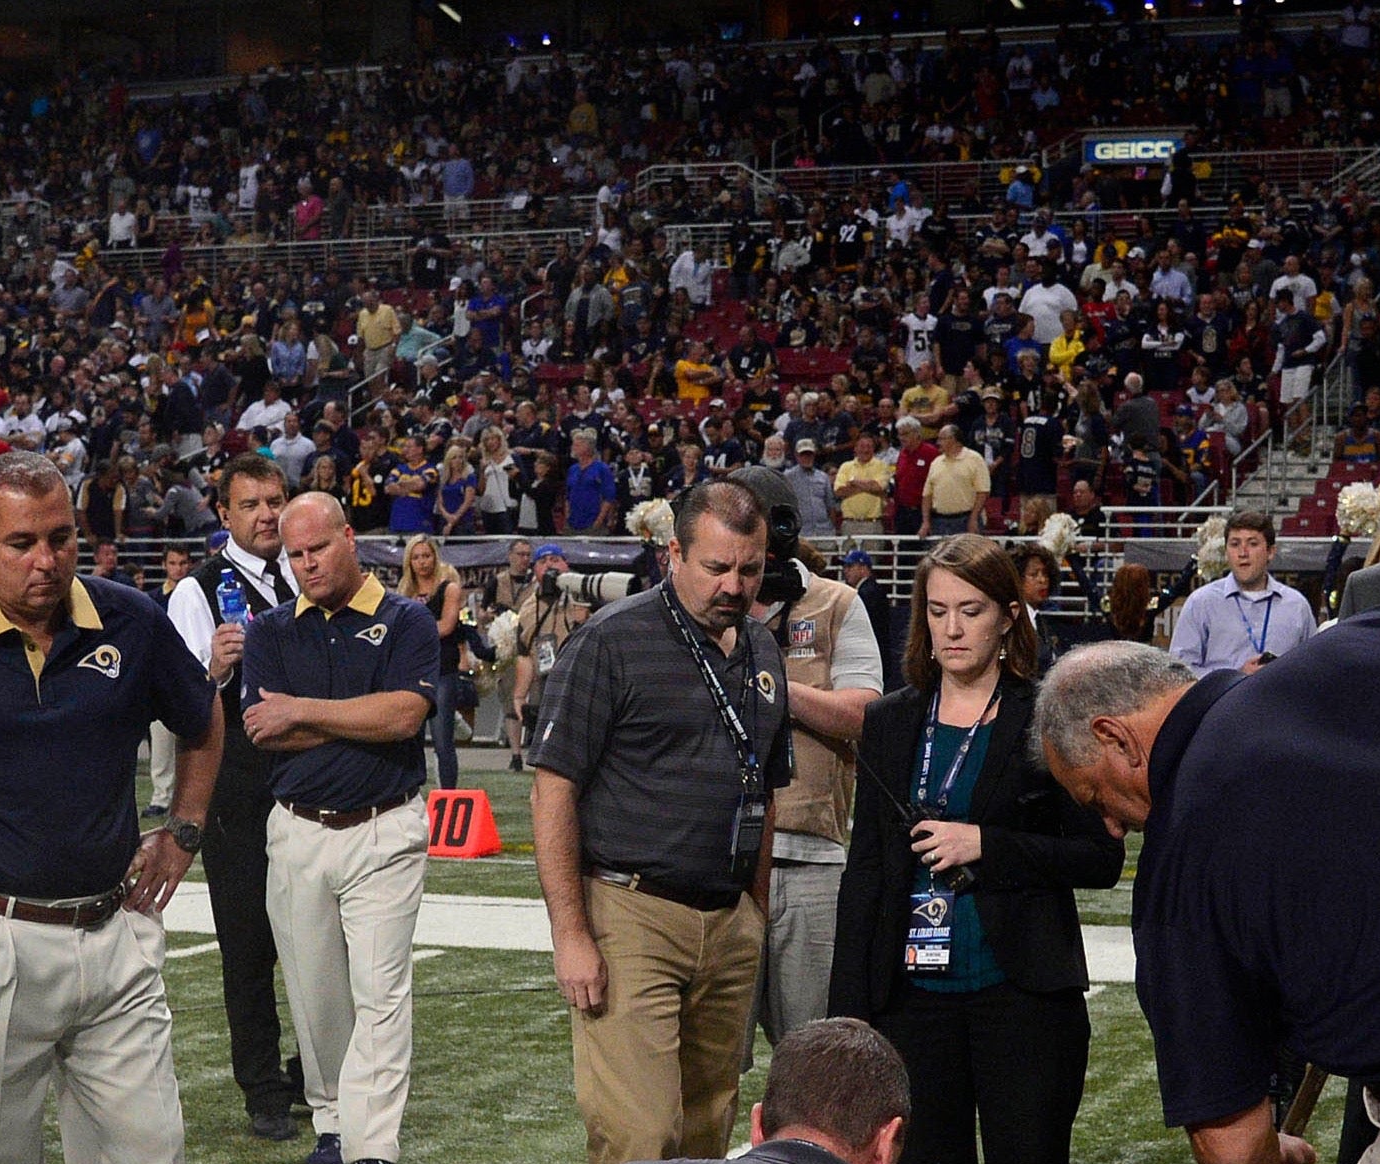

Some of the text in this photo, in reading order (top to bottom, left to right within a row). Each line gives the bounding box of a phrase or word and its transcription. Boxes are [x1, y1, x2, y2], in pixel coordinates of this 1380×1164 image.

[1094, 141, 1176, 160] GEICO
[839, 224, 858, 243] 92
[1021, 427, 1038, 459] 8
[351, 481, 374, 507] 13
[429, 797, 474, 848] 10
[917, 927, 934, 939] LOUIS
[933, 926, 951, 938] RAMS
